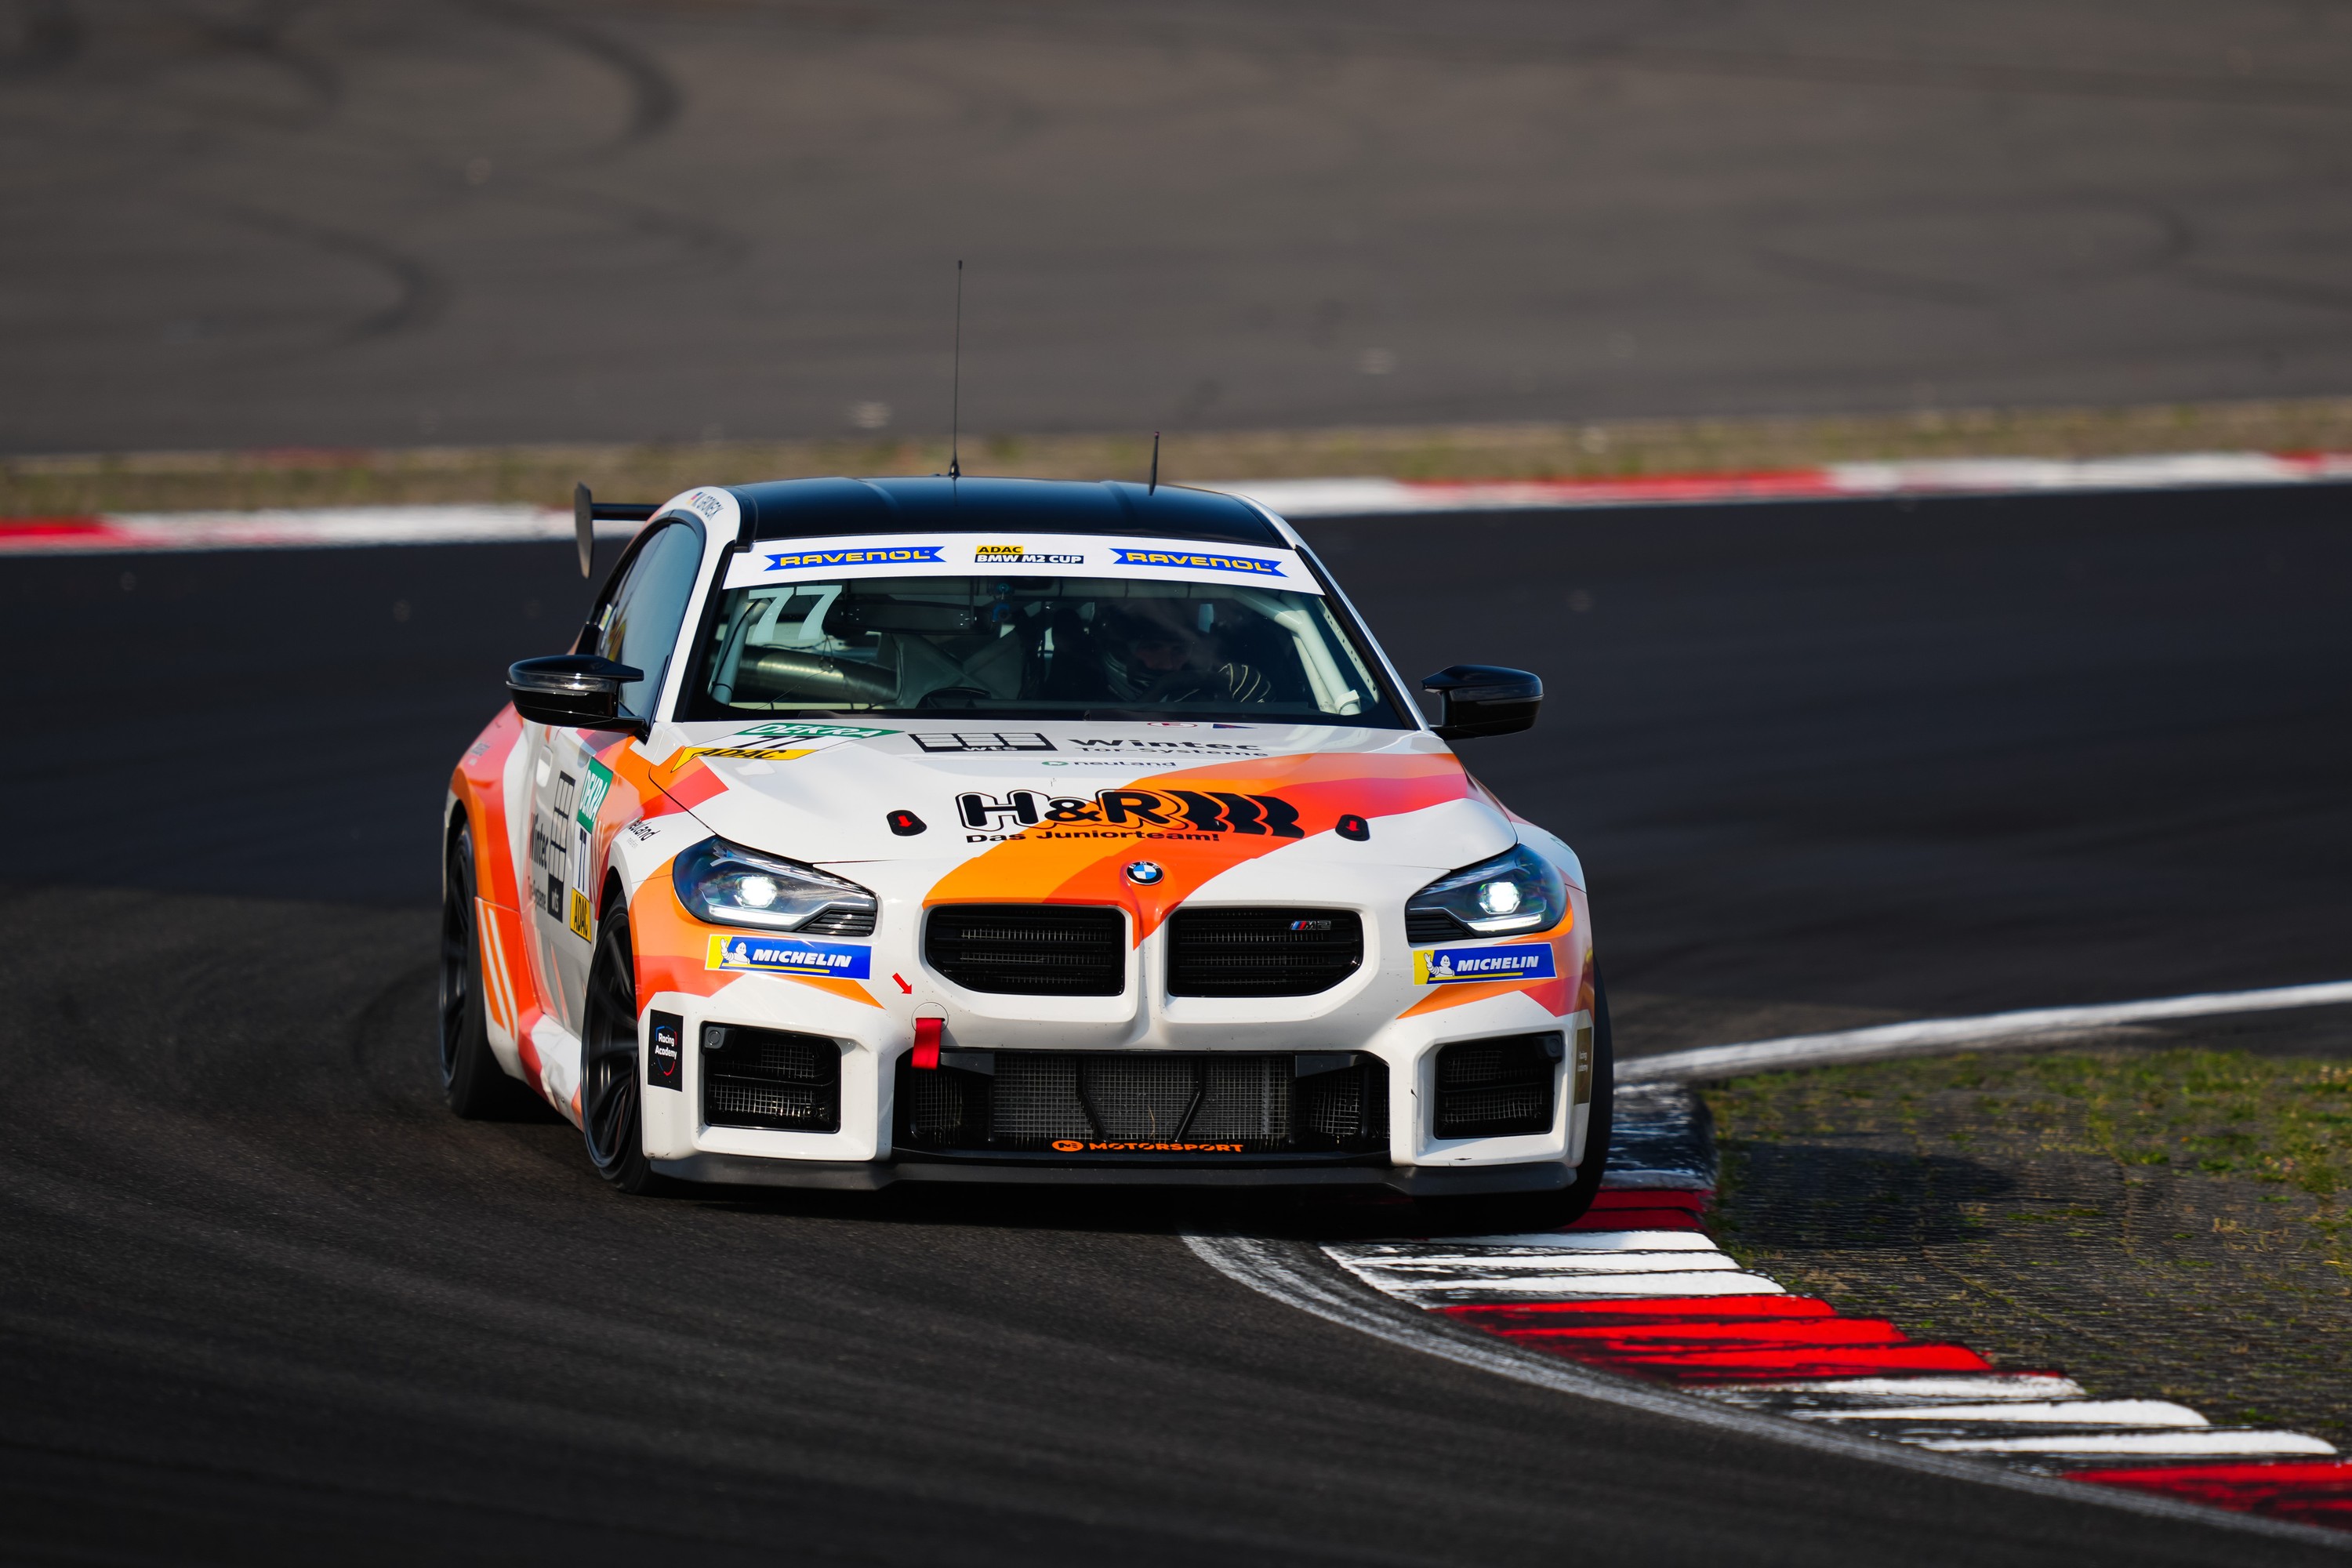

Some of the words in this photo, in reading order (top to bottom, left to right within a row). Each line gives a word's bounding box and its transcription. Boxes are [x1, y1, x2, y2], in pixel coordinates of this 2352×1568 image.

[779, 550, 931, 567] RAVENOL
[1049, 555, 1082, 564] CUP
[1126, 552, 1272, 572] RAVENOL
[748, 585, 843, 644] 77
[745, 724, 883, 738] DEKRA
[1067, 739, 1262, 751] Wintec
[1075, 747, 1269, 757] Tor-Systeme
[690, 748, 787, 760] ADAC
[579, 769, 608, 822] DEKRA
[955, 789, 1185, 833] H&R
[966, 832, 1028, 844] Das
[1036, 829, 1221, 842] Juniorteam!
[573, 894, 588, 937] ADAC
[752, 949, 852, 968] MICHELIN
[1456, 956, 1539, 972] MICHELIN
[658, 1033, 675, 1047] Racing
[655, 1044, 677, 1060] Academy
[1088, 1142, 1244, 1152] MOTORSPORT
